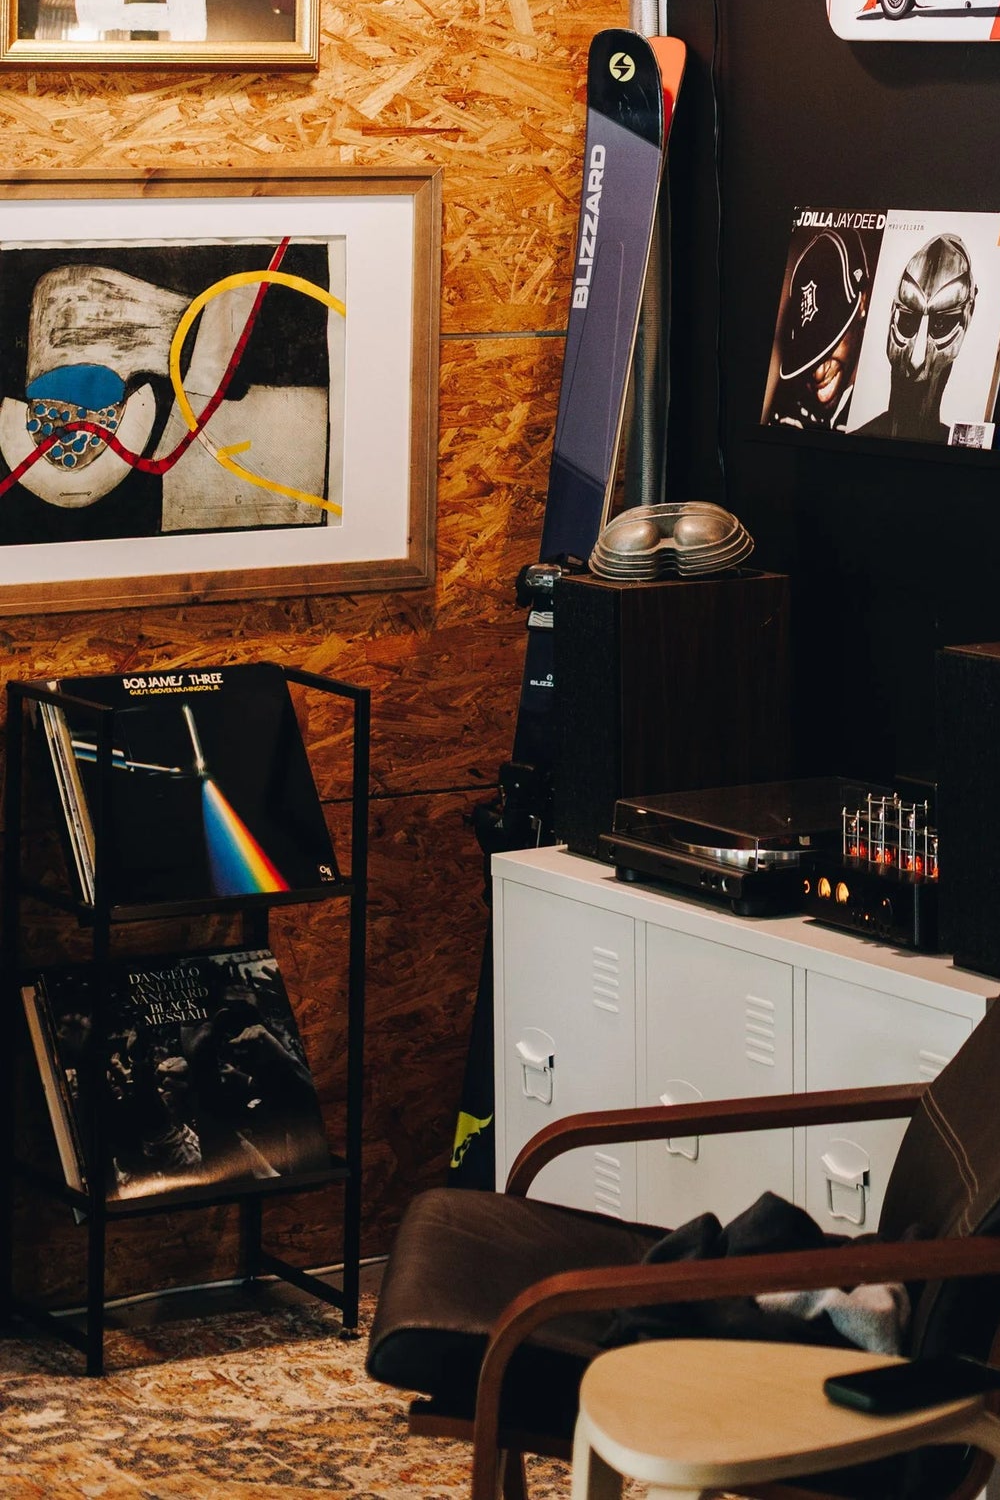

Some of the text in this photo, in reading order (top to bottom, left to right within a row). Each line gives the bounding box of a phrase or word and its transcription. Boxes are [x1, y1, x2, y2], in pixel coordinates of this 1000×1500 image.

[572, 144, 606, 309] BLIZZARD
[833, 213, 854, 228] JAY
[853, 213, 876, 229] DEE
[123, 673, 224, 689] BOB JAMES THREE
[131, 987, 208, 1005] VANGUARD
[150, 999, 197, 1014] BLACK
[144, 1008, 208, 1026] MESSIAH
